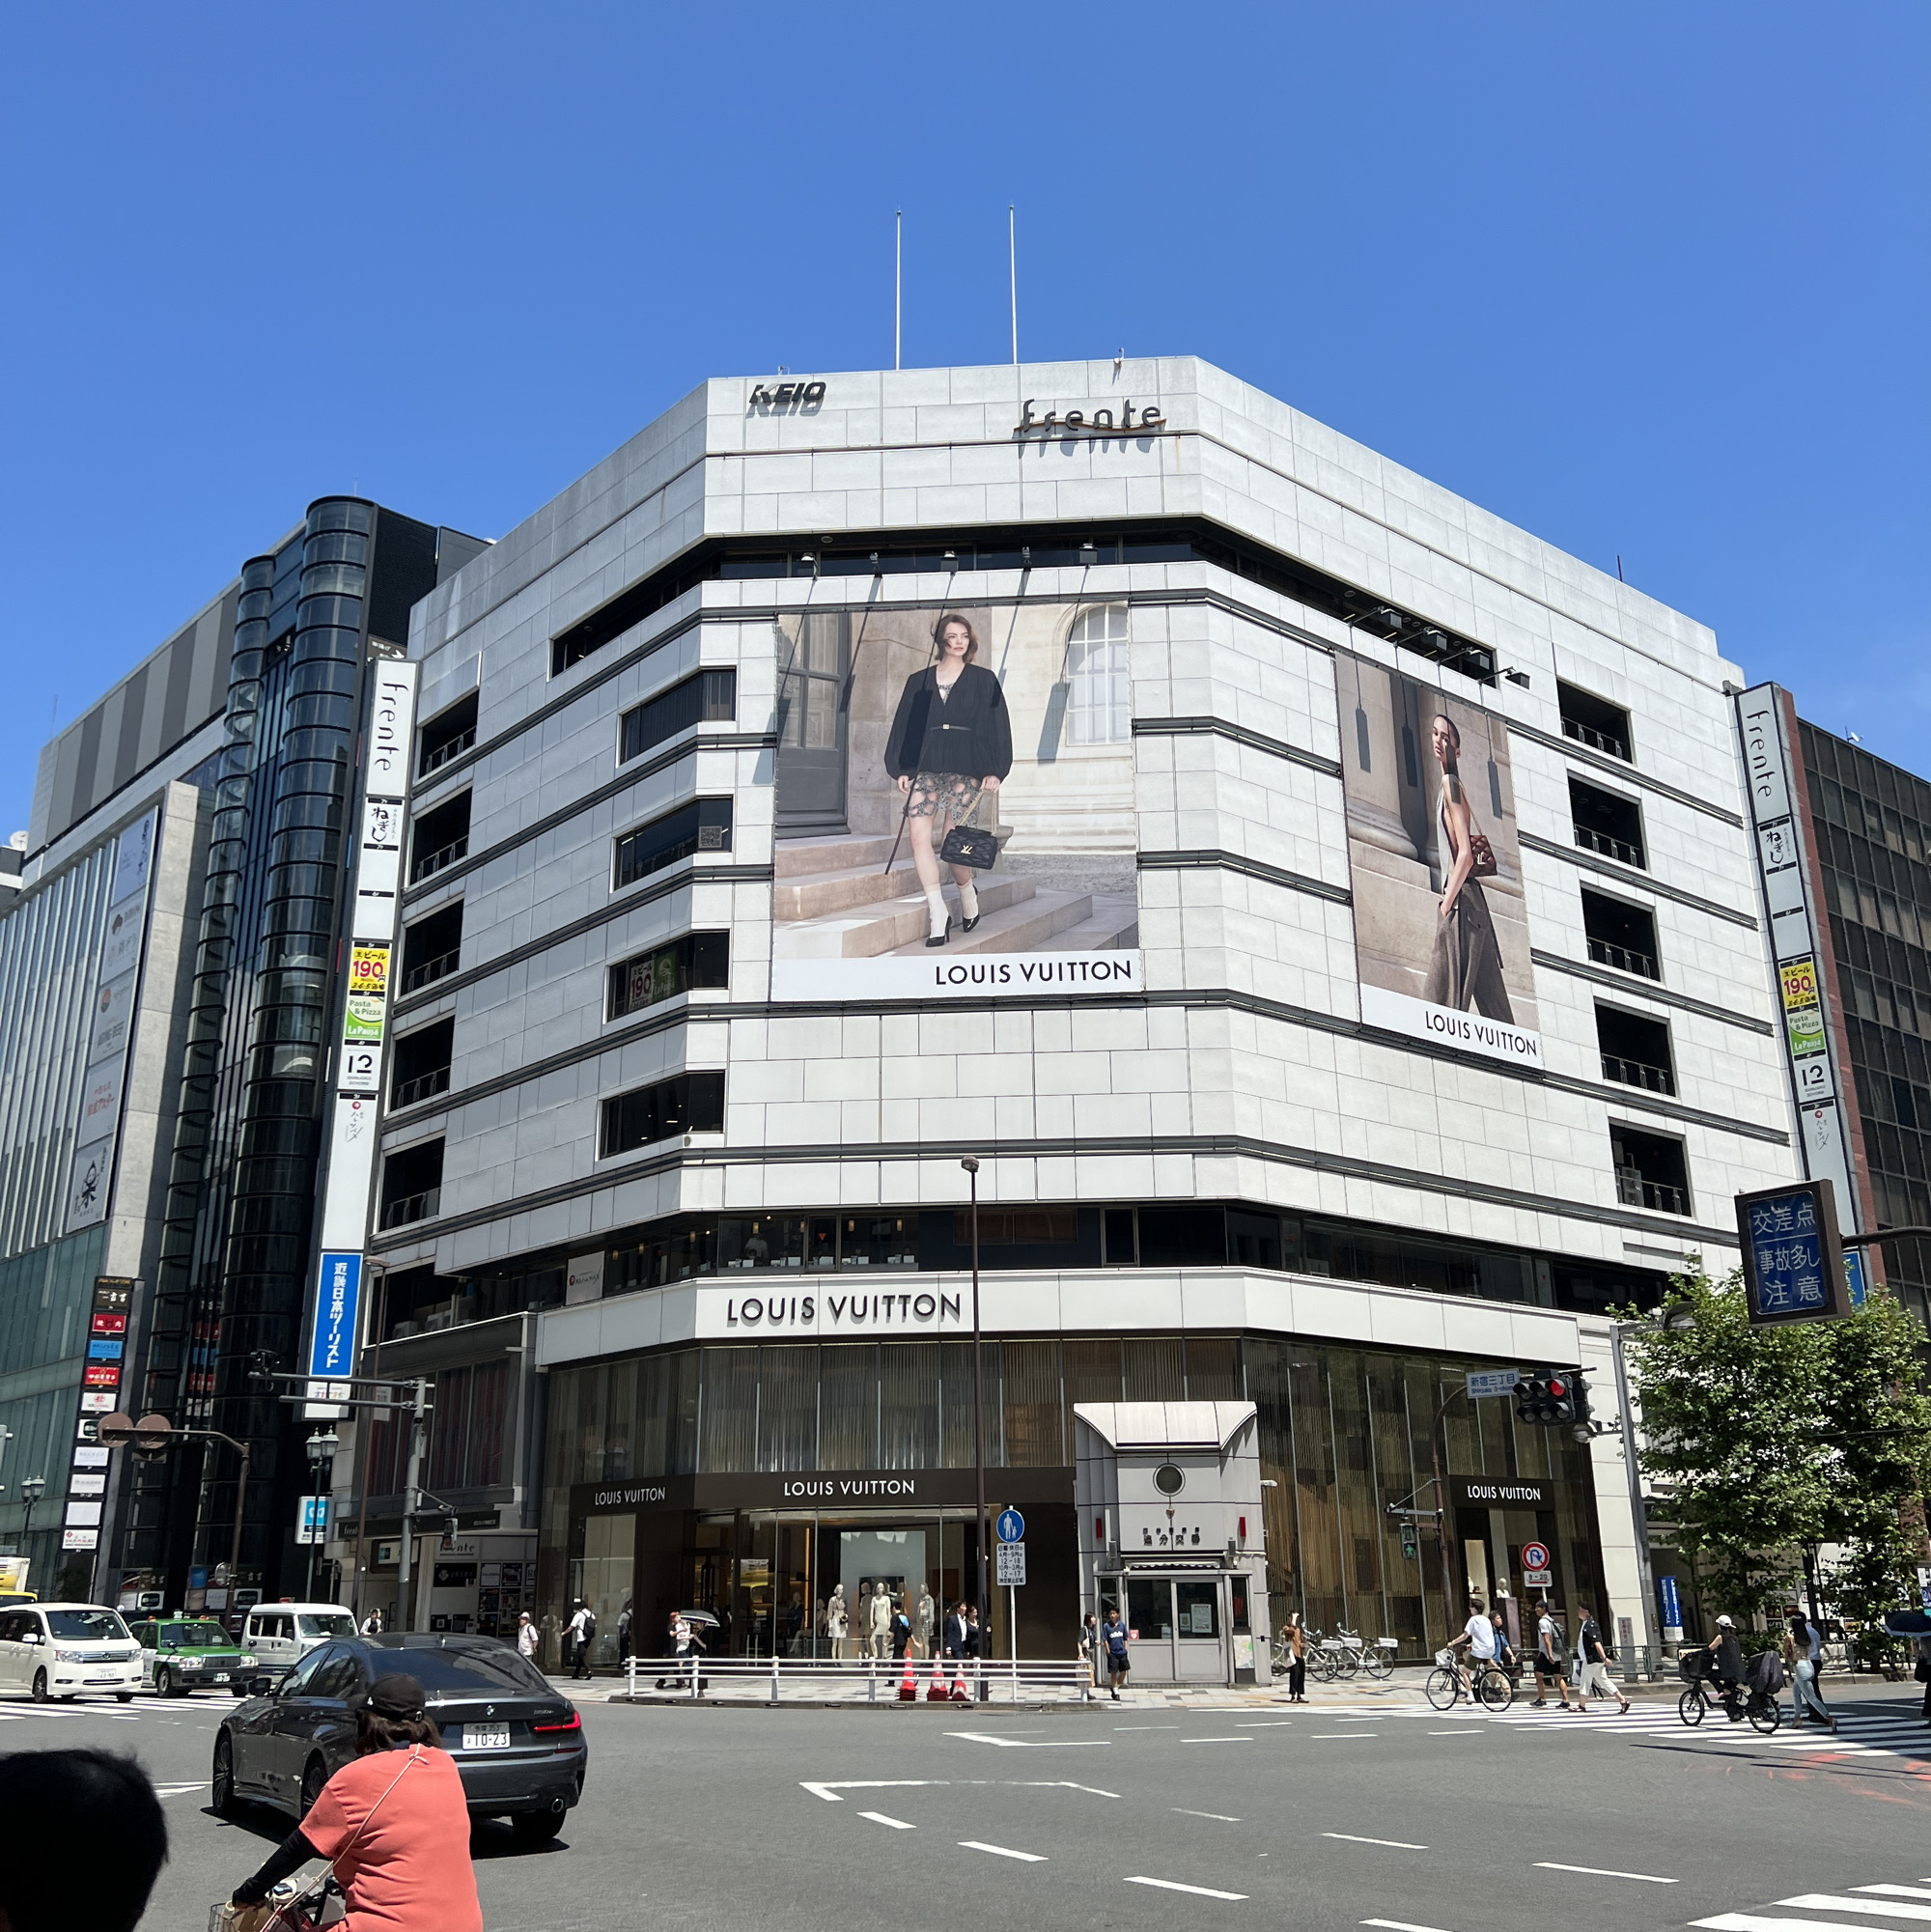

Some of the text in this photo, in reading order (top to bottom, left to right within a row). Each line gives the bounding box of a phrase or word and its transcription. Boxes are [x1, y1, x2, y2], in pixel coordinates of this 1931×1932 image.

[749, 382, 826, 404] KEIO
[1021, 399, 1161, 433] frente
[375, 682, 409, 771] frente
[1746, 710, 1776, 798] frente
[371, 806, 389, 843] ねぎし
[1766, 830, 1783, 864] ねぎし
[630, 972, 652, 1000] 190
[936, 960, 1132, 986] LOUIS VUITTON
[1425, 1010, 1538, 1056] LOUIS VUITTON
[1789, 1015, 1808, 1023] Pasta
[1802, 1020, 1819, 1028] Pizza
[1752, 1201, 1816, 1236] 交差点
[1758, 1244, 1821, 1274] 事故多し
[1764, 1274, 1823, 1306] 注意
[326, 1262, 349, 1369] 近畿日本ツーリスト
[727, 1293, 962, 1323] LOUIS VUITTON
[1470, 1373, 1516, 1387] 新宿三丁目
[595, 1486, 666, 1506] LOUIS VUITTON
[784, 1479, 915, 1497] LOUIS VUITTON
[1467, 1485, 1541, 1501] LOUIS VUITTON
[475, 1732, 508, 1747] 10-23
